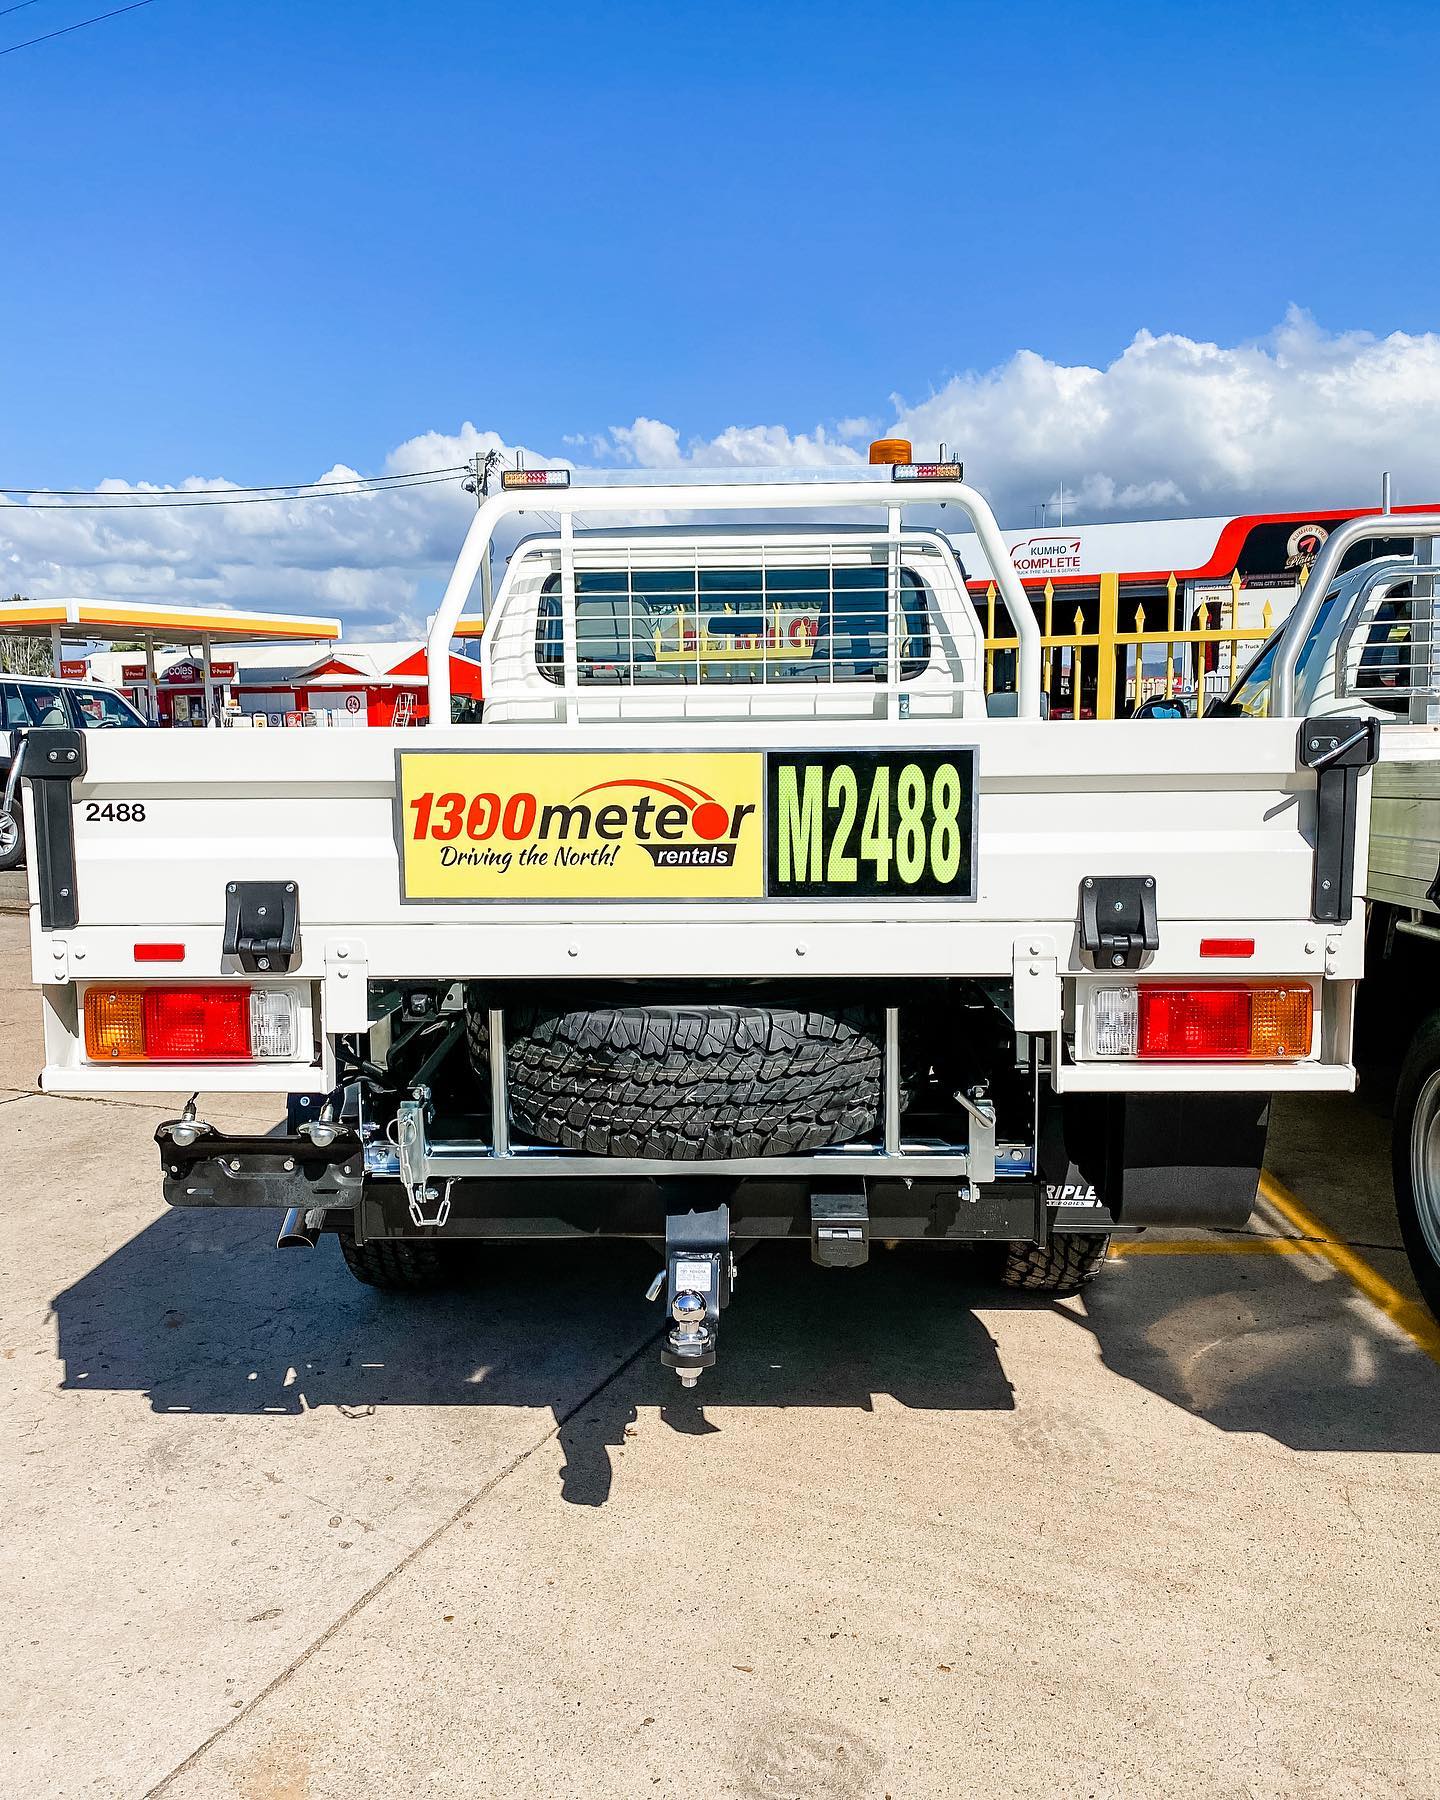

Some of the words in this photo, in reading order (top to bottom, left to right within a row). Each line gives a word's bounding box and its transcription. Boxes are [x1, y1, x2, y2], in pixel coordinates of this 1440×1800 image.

[1030, 545, 1067, 555] KUMHO
[1013, 556, 1081, 570] KOMPLETE
[85, 802, 147, 823] 2488
[778, 763, 961, 884] M2488
[440, 844, 514, 874] Driving
[518, 843, 549, 866] the
[553, 843, 621, 867] North!
[656, 846, 729, 865] rentals
